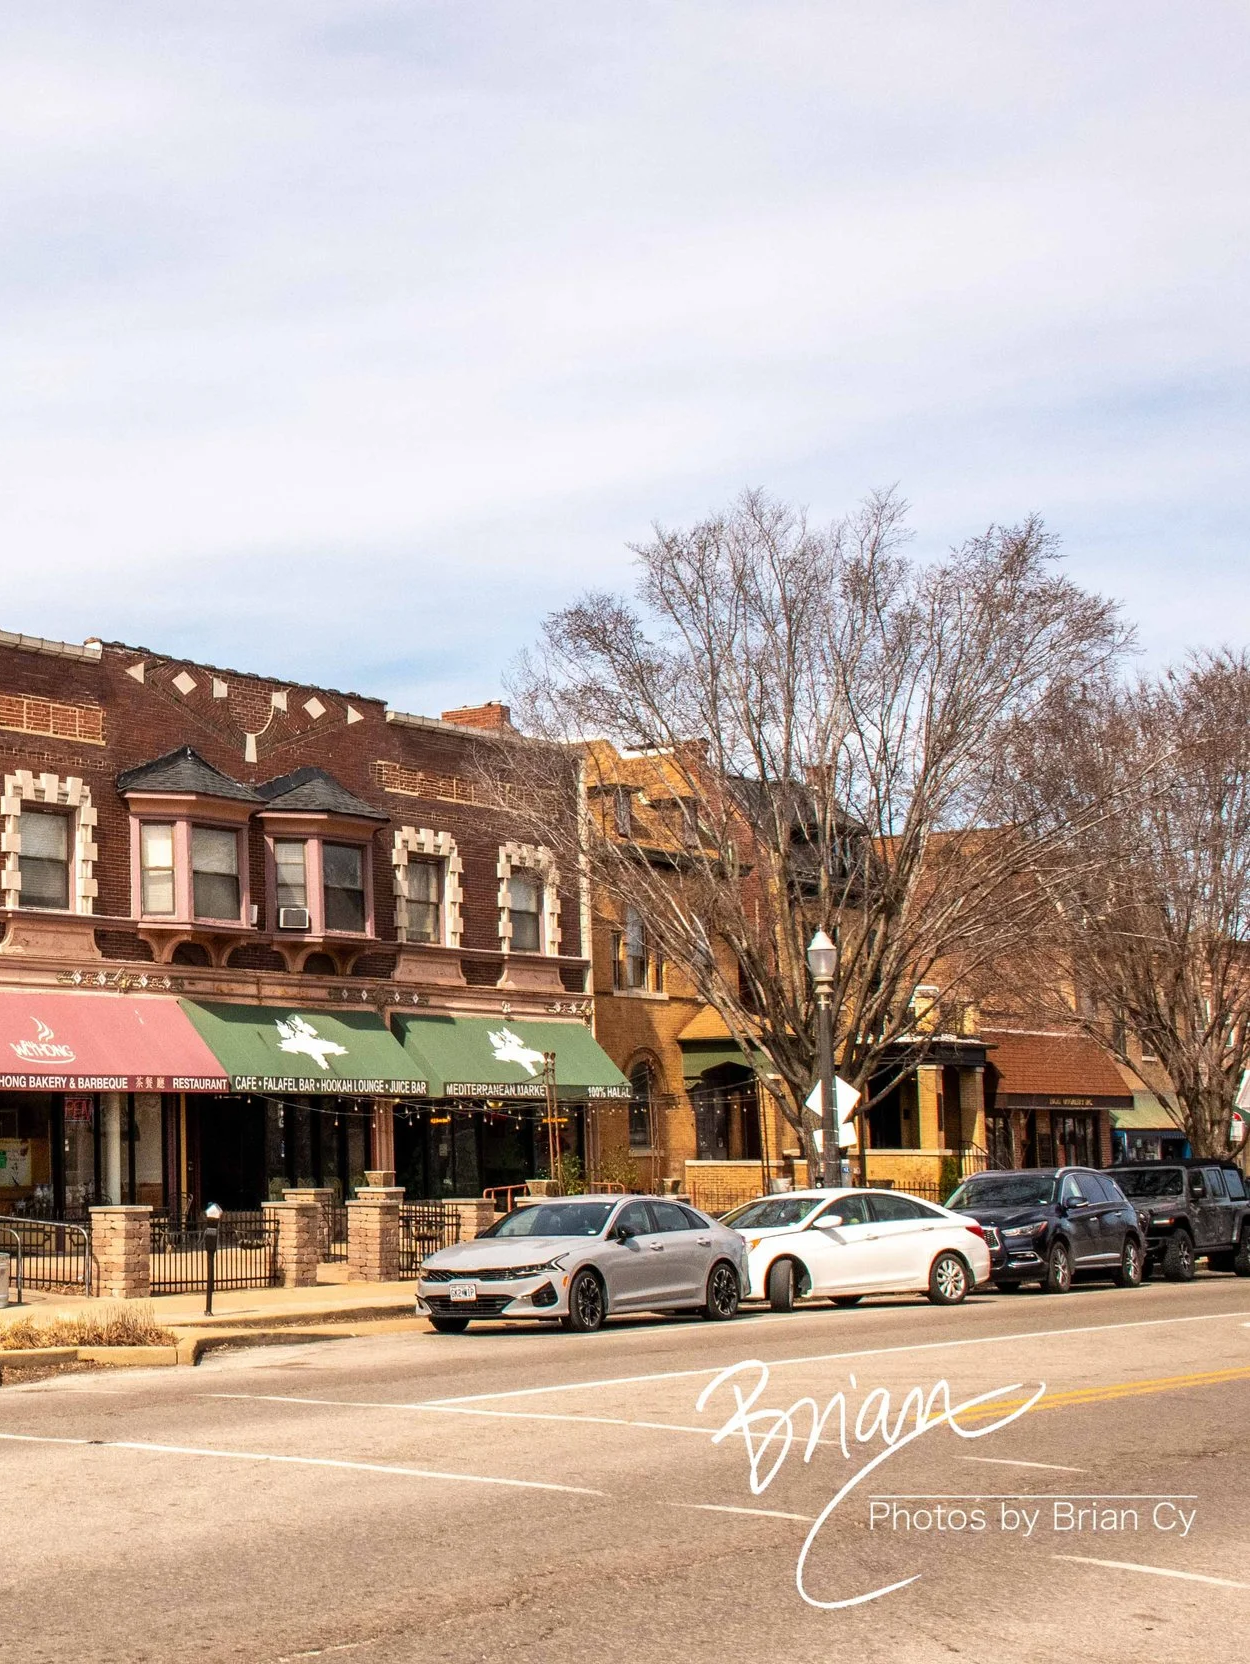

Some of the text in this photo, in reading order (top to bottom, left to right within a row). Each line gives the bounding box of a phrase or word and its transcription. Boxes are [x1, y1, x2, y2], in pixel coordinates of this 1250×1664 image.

[28, 1076, 67, 1089] BAKERY
[69, 1077, 76, 1088] &
[78, 1077, 128, 1090] BARBEQUE
[172, 1077, 228, 1090] RESTAURANT
[235, 1076, 427, 1094] CAFE FALAFEL BAR HOOKAH LOUNGE JUICE BAR
[446, 1083, 548, 1097] MEDITERRANEAN MARKET
[588, 1086, 631, 1098] 100% HALAL
